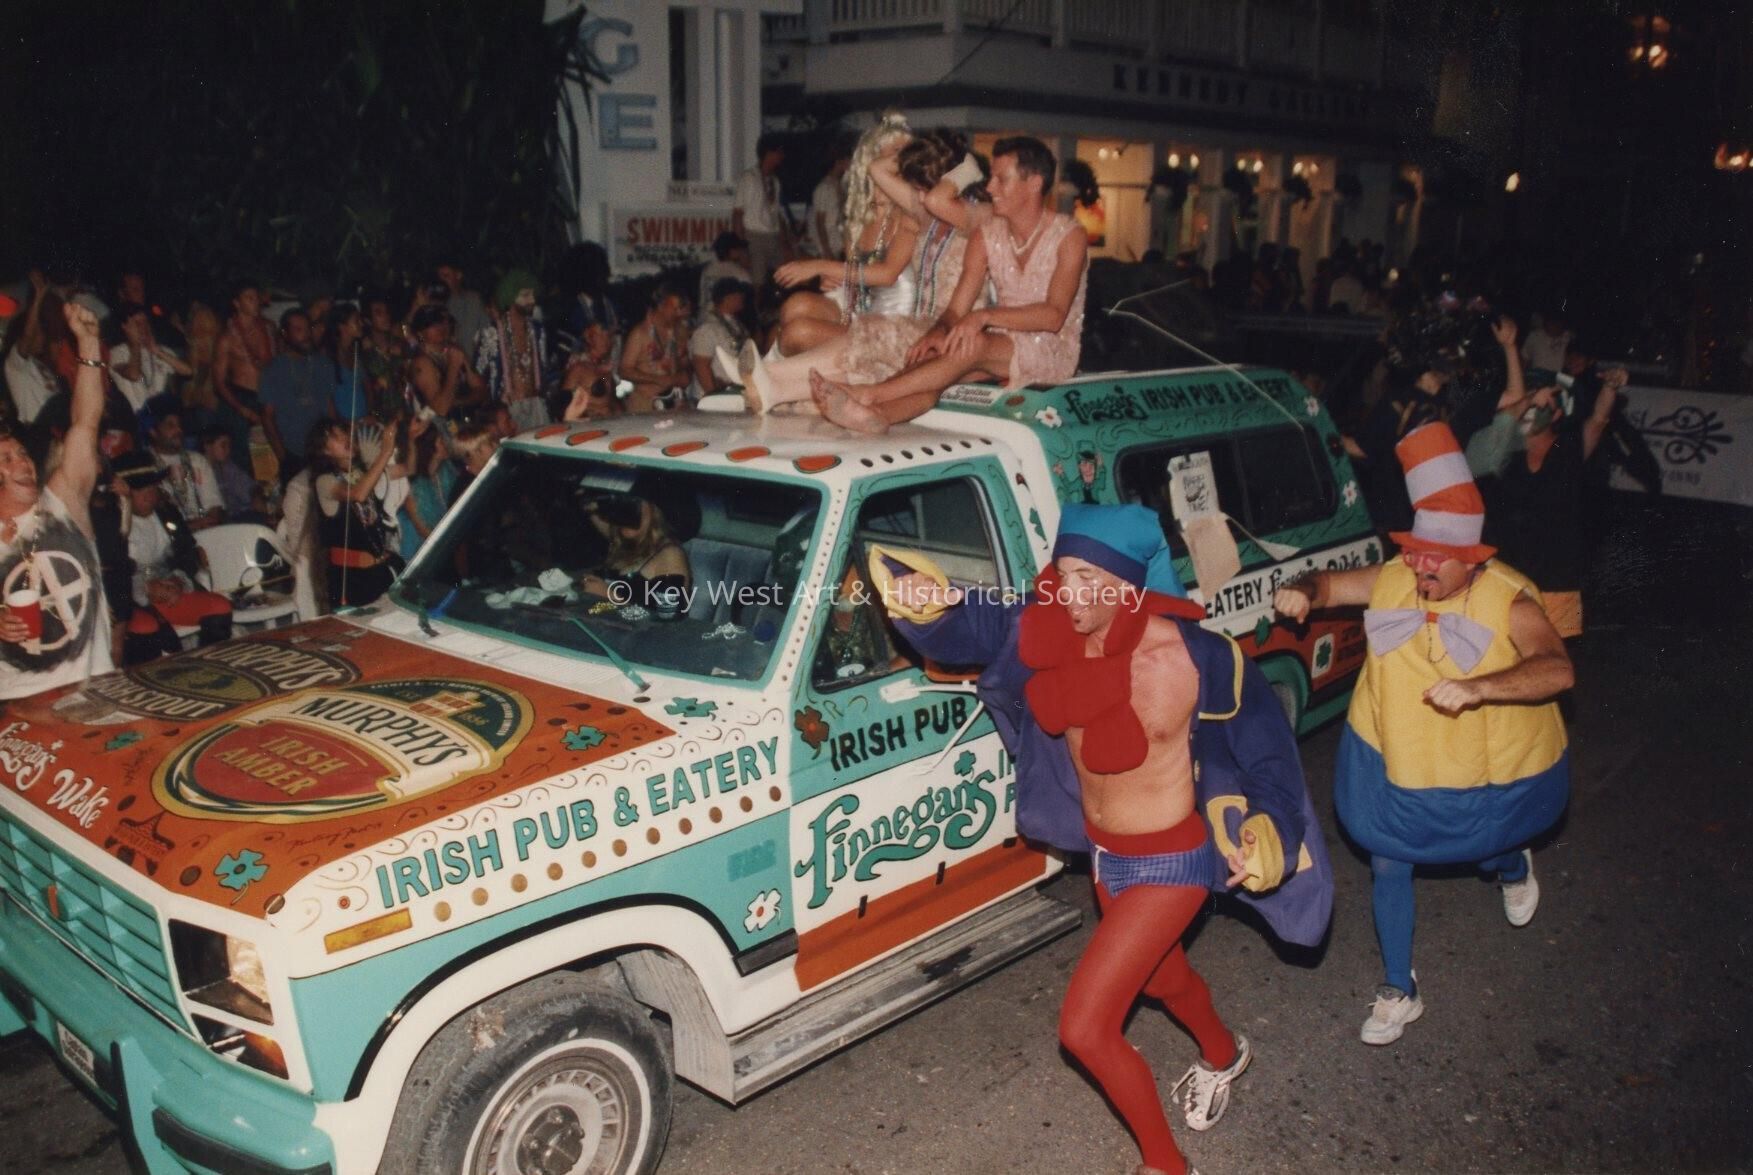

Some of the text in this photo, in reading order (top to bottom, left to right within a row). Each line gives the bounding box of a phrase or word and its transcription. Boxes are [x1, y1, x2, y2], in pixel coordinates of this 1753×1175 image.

[1140, 384, 1191, 410] IRISH
[1188, 382, 1226, 406] PUB
[258, 735, 349, 775] IRISH
[829, 696, 968, 772] IRISH PUB
[46, 768, 110, 829] Wake
[212, 747, 318, 796] AMBER
[376, 828, 504, 909] IRISH
[512, 798, 599, 861] PUB
[613, 786, 640, 828] &
[645, 736, 779, 817] EATERY
